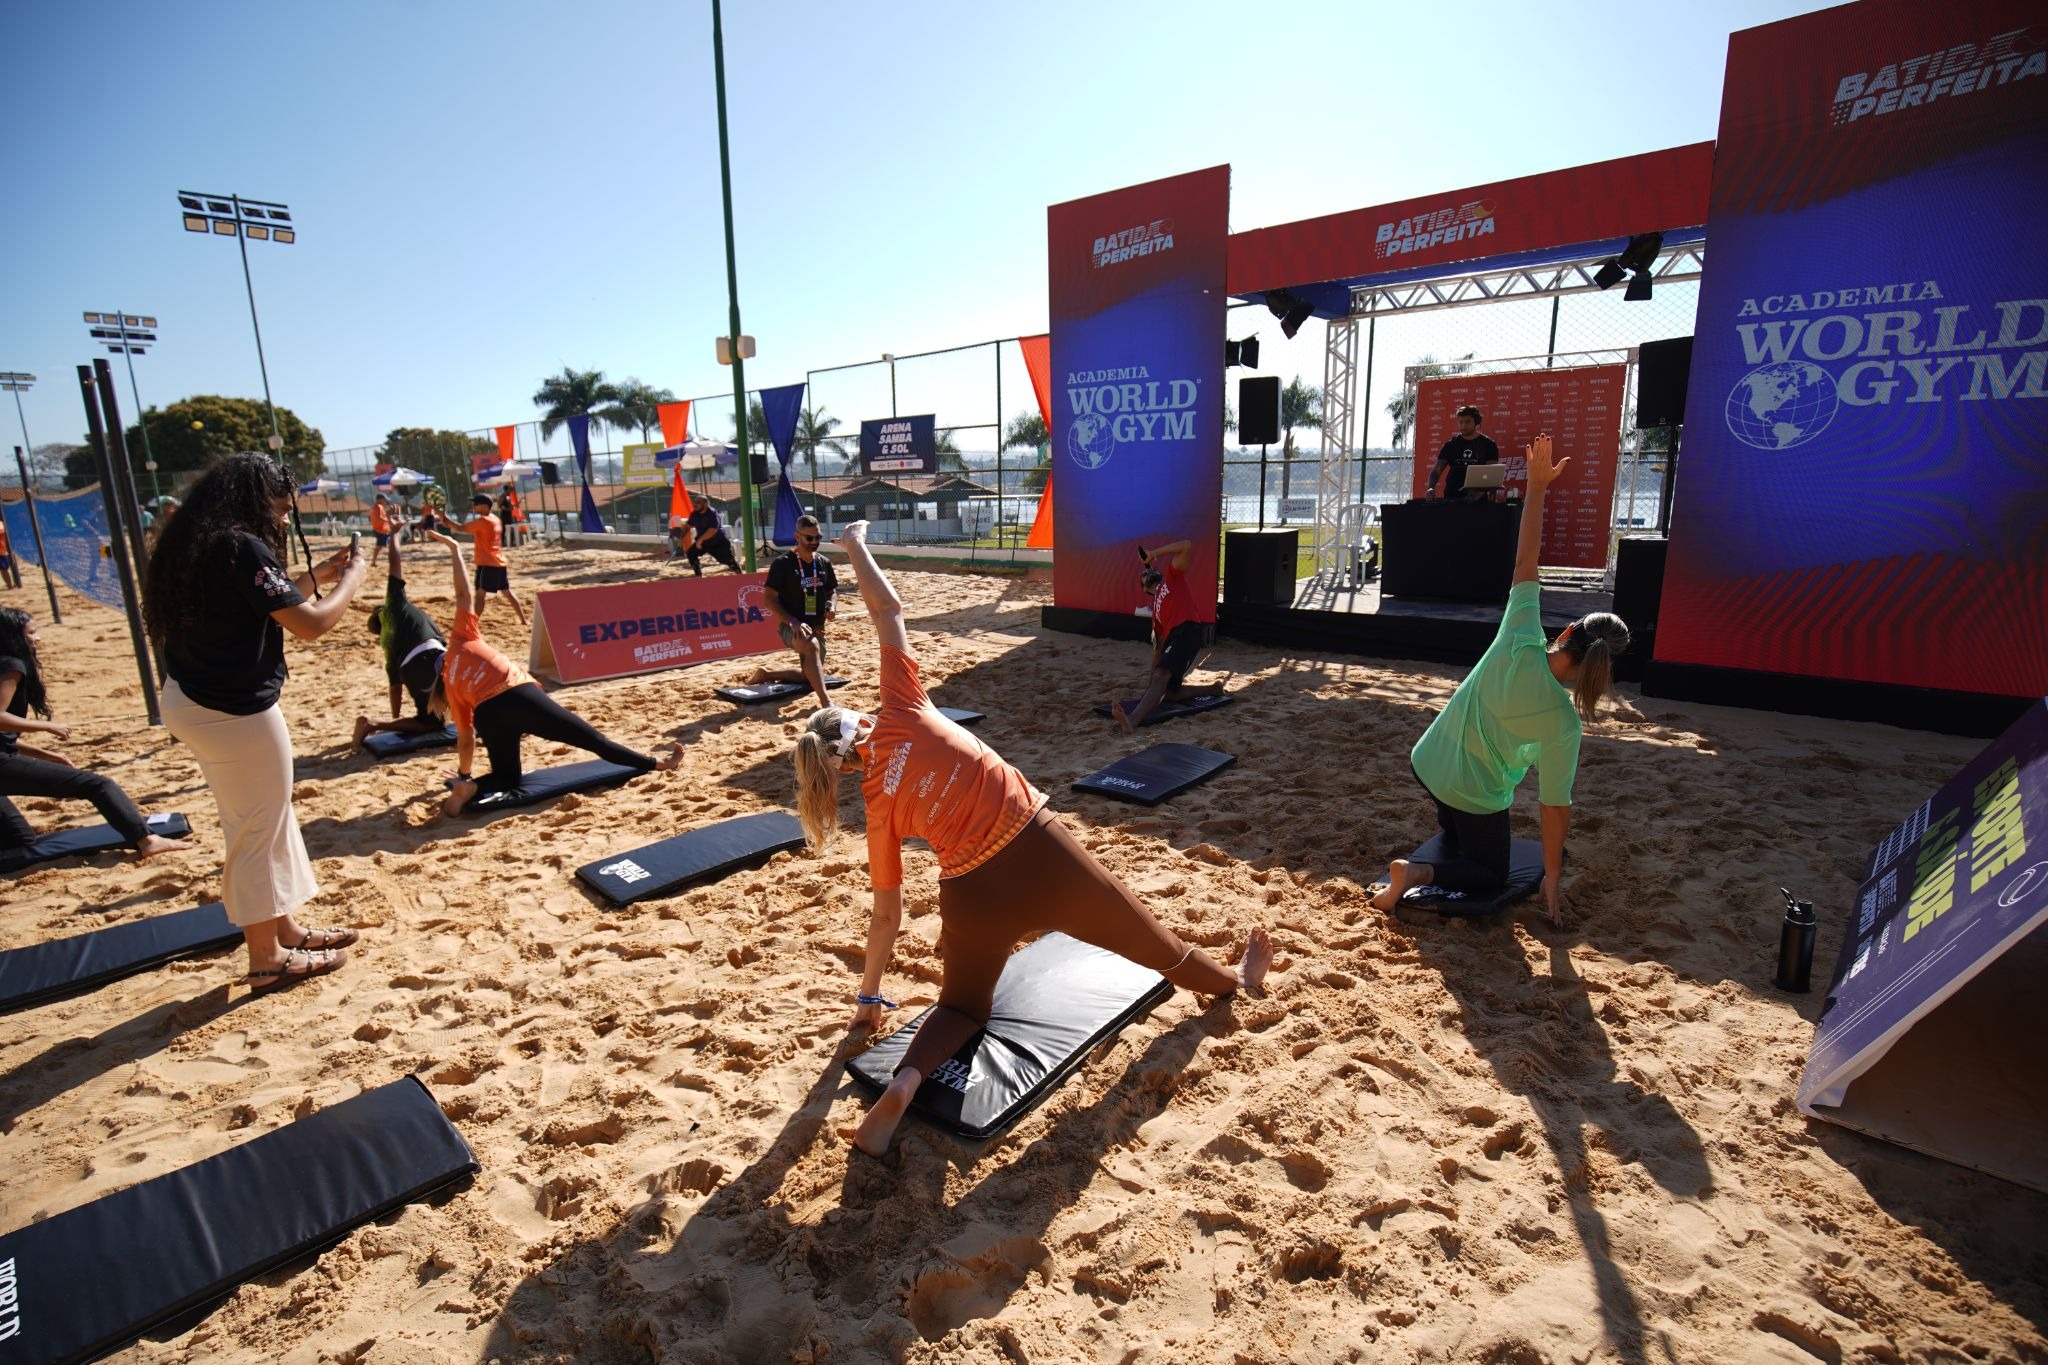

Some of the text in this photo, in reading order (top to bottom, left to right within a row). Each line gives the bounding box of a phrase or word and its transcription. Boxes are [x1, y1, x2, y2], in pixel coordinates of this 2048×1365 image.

[1834, 28, 2030, 103] BATIDA
[1848, 51, 2048, 122] PERFEITA
[1093, 219, 1165, 255] BATIDA
[1376, 200, 1481, 243] BATIDA
[1385, 217, 1495, 257] PERFEITA
[1100, 234, 1174, 268] PERFEITA
[1737, 280, 1944, 317] ACADEMIA
[1735, 299, 2048, 365] WORLD
[1067, 366, 1150, 384] ACADEMIA
[1838, 350, 2048, 406] GYM
[1067, 379, 1198, 415] WORLD
[878, 433, 912, 445] SAMBA
[881, 422, 912, 434] ARENA
[1112, 411, 1197, 442] GYM
[881, 444, 909, 454] & SOL
[579, 606, 765, 645] EXPERIÊNCIA
[634, 638, 690, 657] BATIDA
[642, 647, 693, 665] PERFEITA
[1971, 755, 2027, 894] ESPORTE
[1903, 824, 1969, 943] SAÚDE
[940, 1058, 985, 1083] RLD
